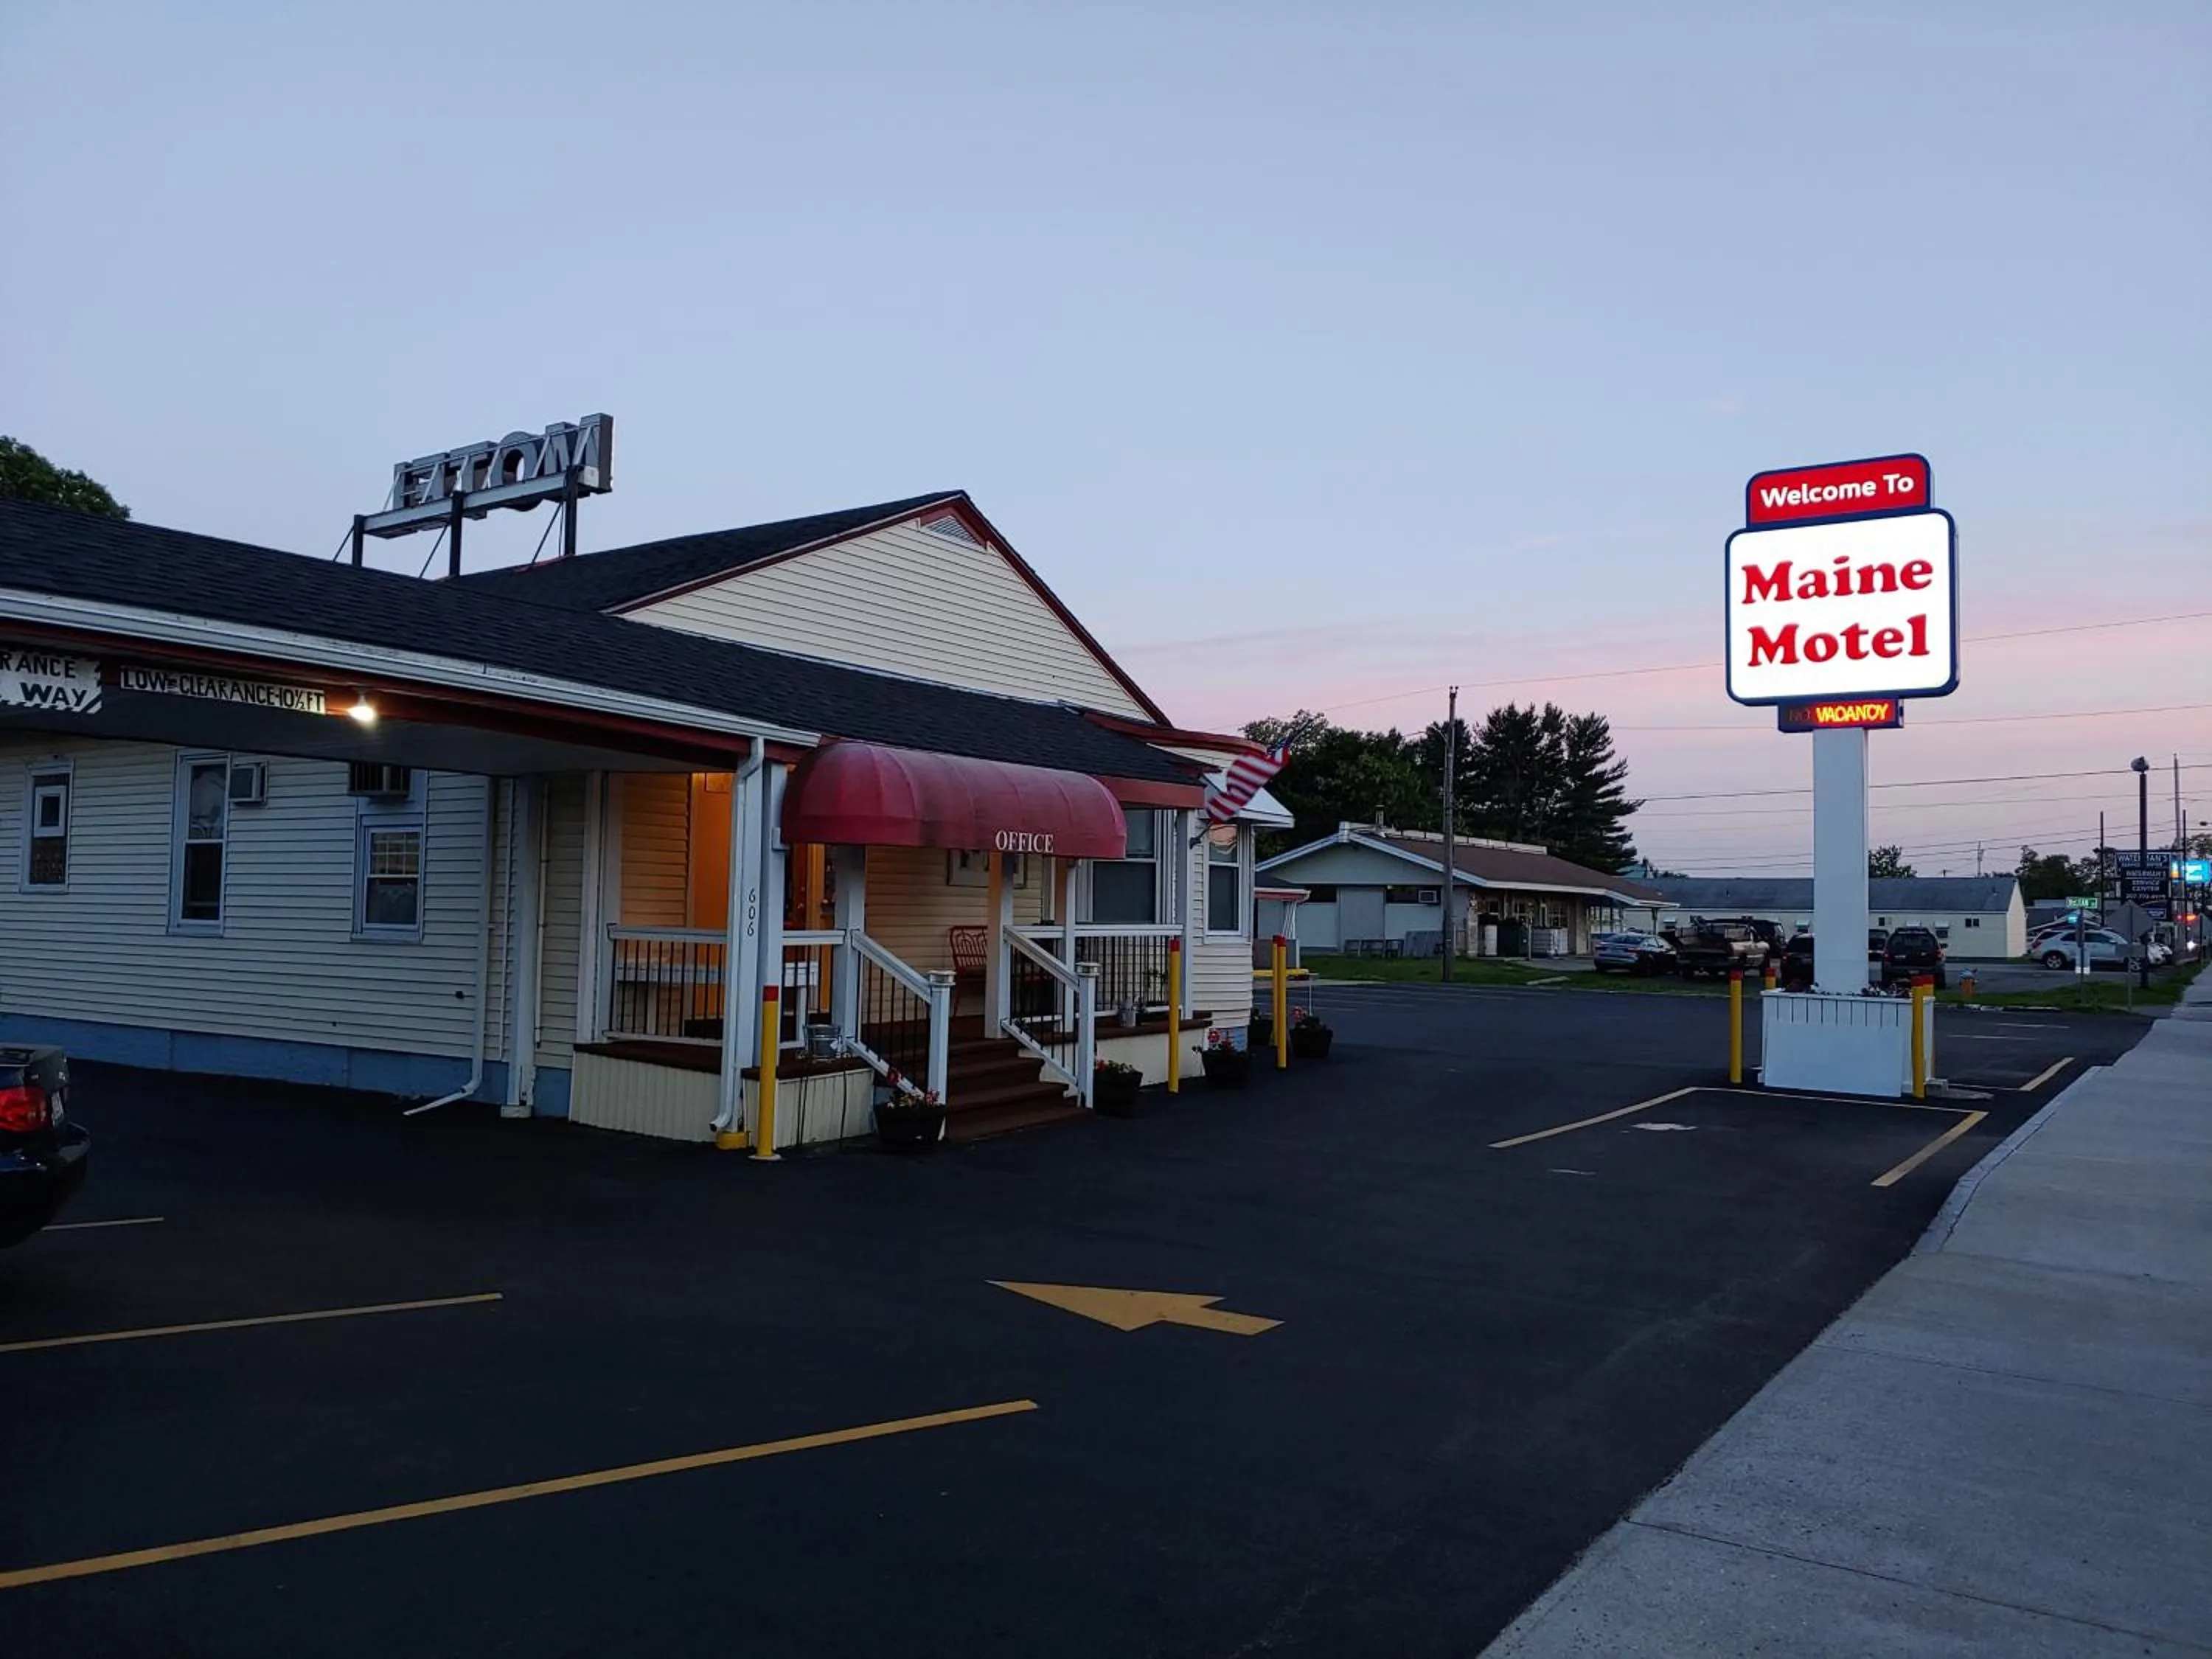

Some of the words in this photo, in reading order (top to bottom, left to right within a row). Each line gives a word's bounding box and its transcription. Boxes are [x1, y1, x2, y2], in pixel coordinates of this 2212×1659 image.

[1761, 479, 1877, 508] Welcome
[1884, 473, 1914, 493] To
[1742, 555, 1933, 604] Maine
[1747, 613, 1930, 667] Motel
[0, 652, 76, 678] RANCE
[19, 682, 86, 706] WAY
[1816, 703, 1888, 722] VACANCY
[995, 830, 1054, 853] OFFICE
[747, 888, 756, 937] 606
